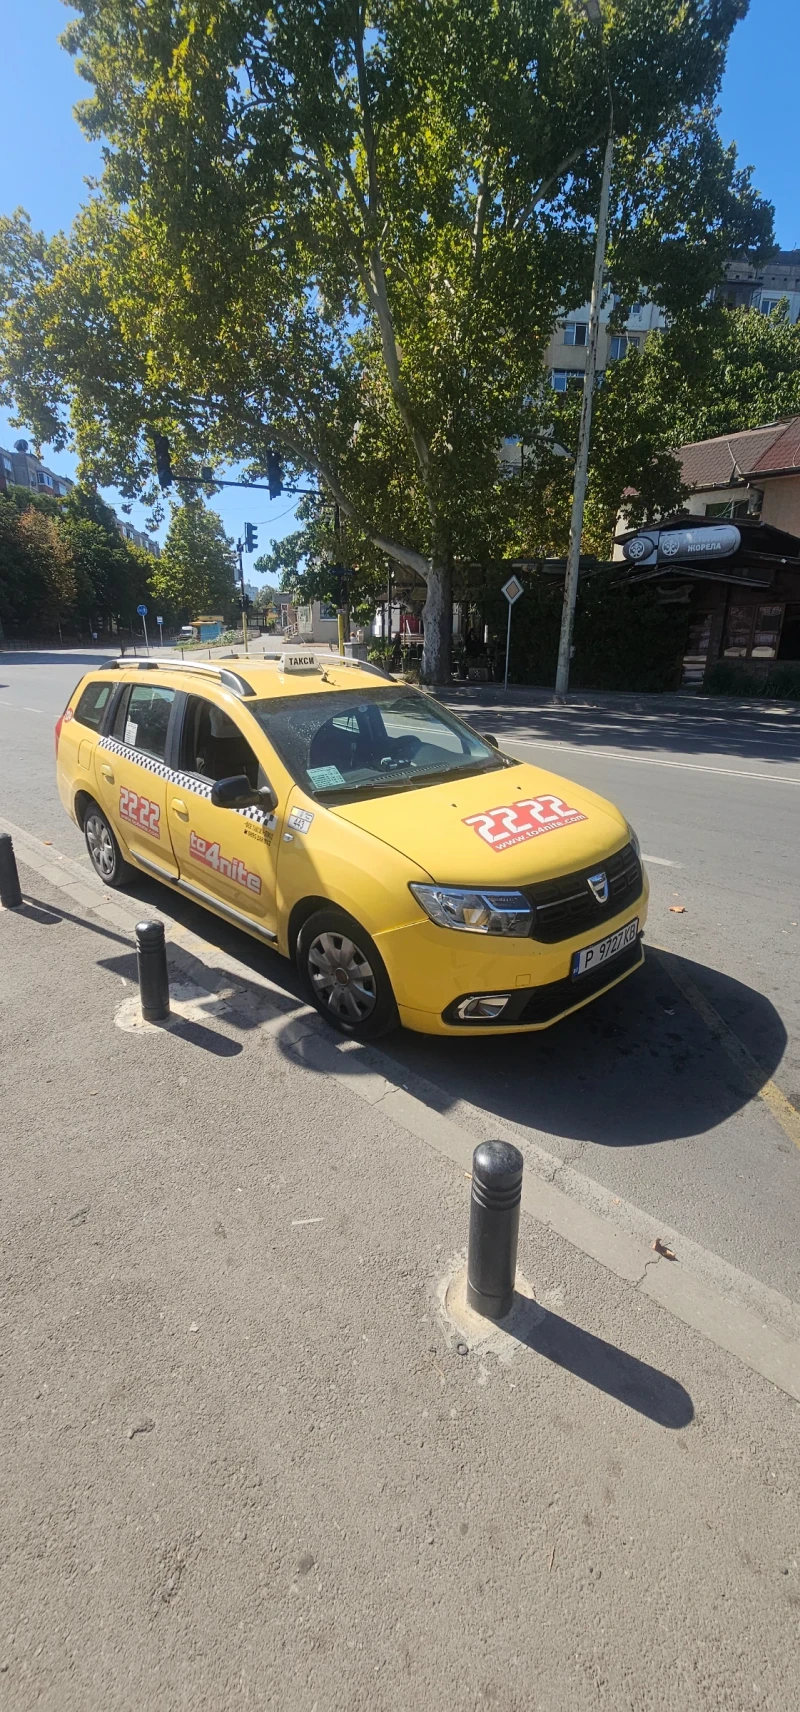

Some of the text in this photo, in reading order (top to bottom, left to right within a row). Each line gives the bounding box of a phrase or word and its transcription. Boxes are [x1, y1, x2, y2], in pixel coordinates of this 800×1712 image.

[688, 542, 721, 552] ЖОРЕЛА
[289, 657, 315, 665] ТАКСИ
[293, 817, 305, 830] 443
[495, 814, 586, 850] www.to4nite.com
[190, 831, 261, 895] to4nite
